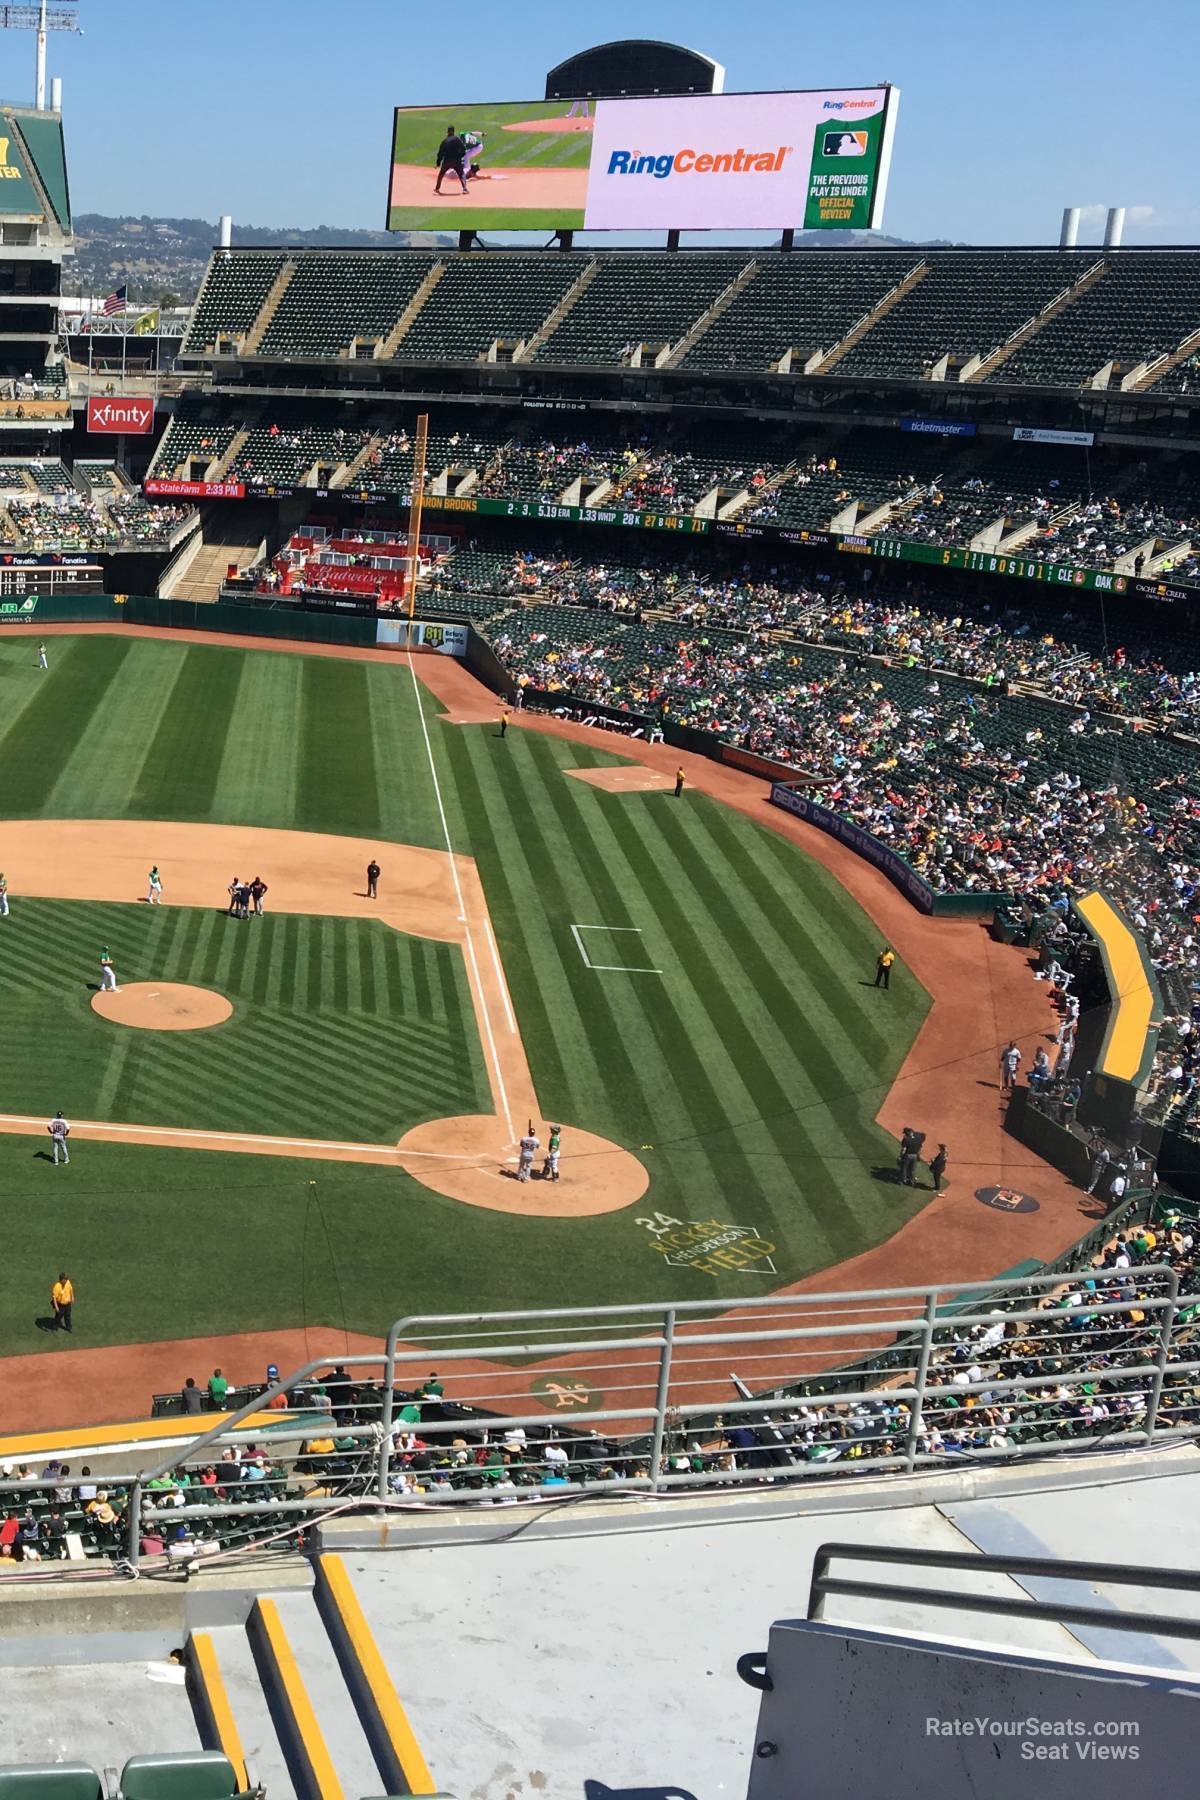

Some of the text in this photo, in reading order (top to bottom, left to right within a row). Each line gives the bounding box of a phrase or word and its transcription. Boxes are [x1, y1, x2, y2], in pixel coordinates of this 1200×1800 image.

[823, 100, 876, 110] RingCentral
[813, 174, 868, 185] THE PREVIOUS
[810, 186, 868, 197] PLAY IS UNDER
[819, 198, 854, 208] OFFICIAL
[820, 209, 852, 219] REVIEW
[93, 404, 150, 427] xfinity
[911, 422, 962, 435] ticketmaster
[205, 485, 238, 496] 2:33 PM
[401, 496, 412, 507] 35
[444, 497, 477, 511] BROOKS
[539, 506, 557, 518] 5.19
[558, 508, 570, 518] ERA
[579, 509, 597, 521] 1.33
[598, 511, 616, 522] WHIP
[623, 513, 634, 525] 28
[313, 565, 389, 583] Budweiser
[1058, 568, 1072, 582] CLE
[1095, 574, 1112, 589] OAK
[1136, 584, 1157, 593] CACHE
[426, 625, 443, 640] 811
[773, 788, 807, 816] GEICO
[634, 1212, 685, 1235] 24
[649, 1218, 728, 1254] RICKEY
[671, 1229, 749, 1262] HENDERSON
[689, 1239, 777, 1277] FIELD
